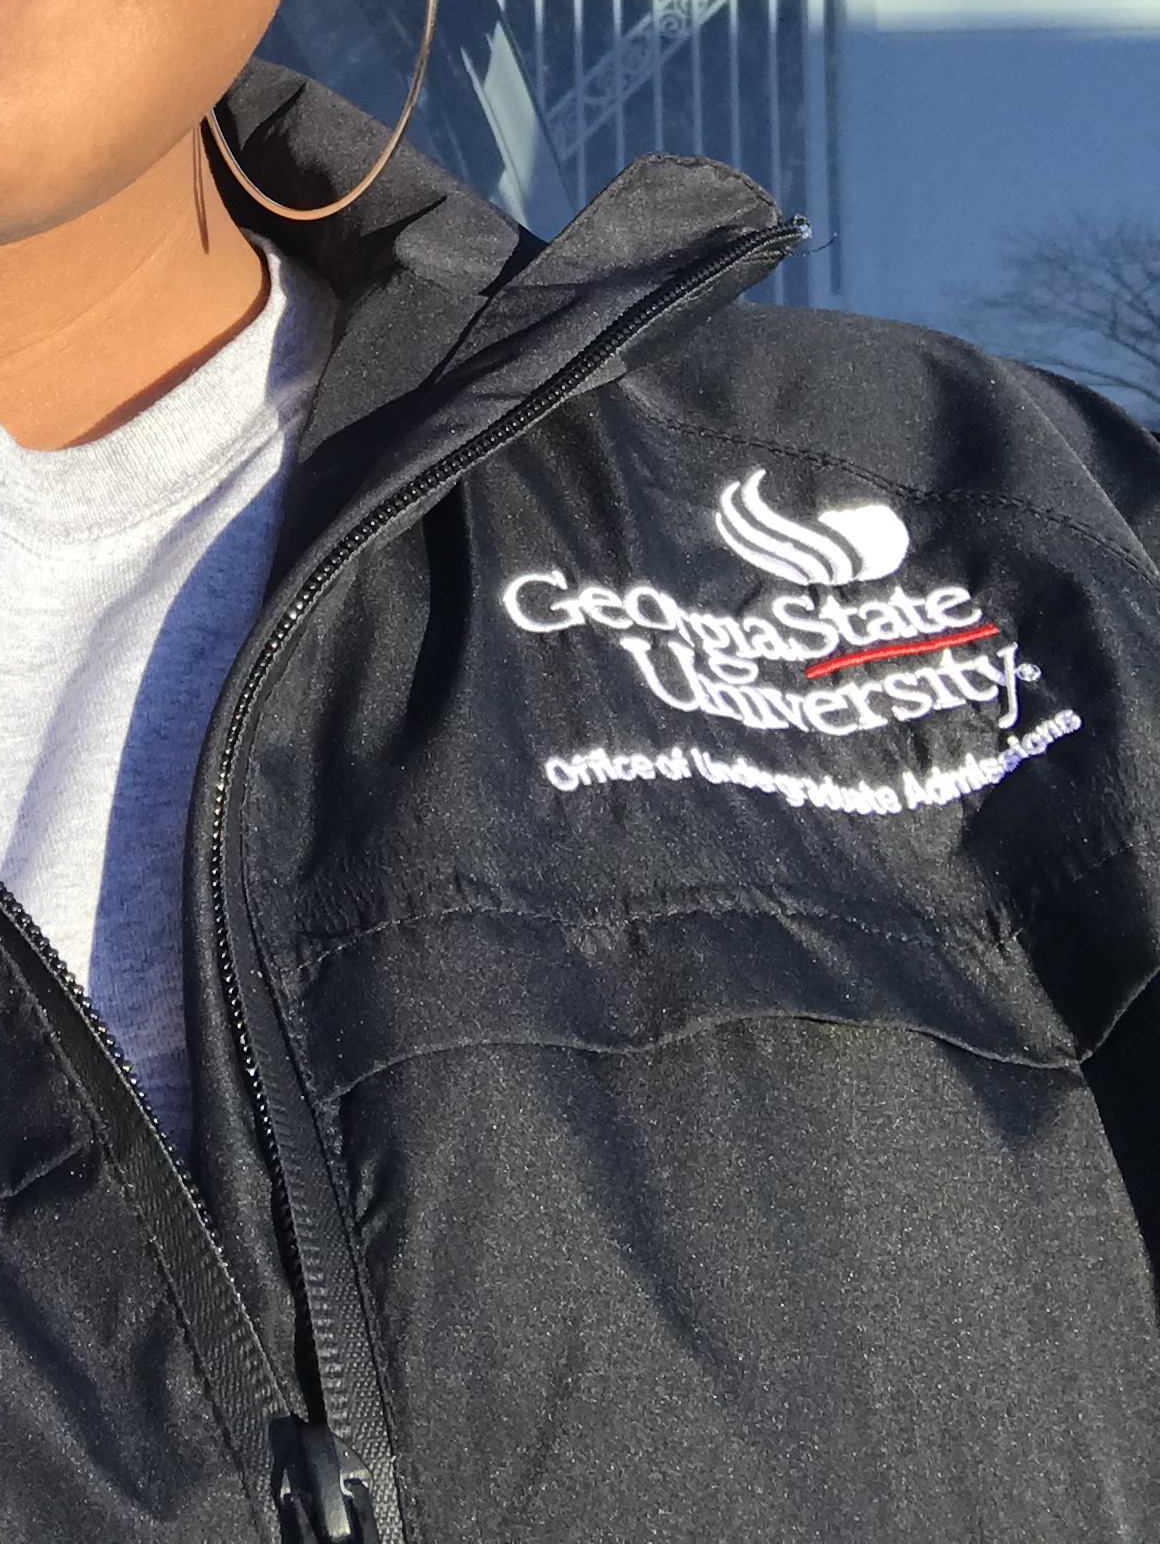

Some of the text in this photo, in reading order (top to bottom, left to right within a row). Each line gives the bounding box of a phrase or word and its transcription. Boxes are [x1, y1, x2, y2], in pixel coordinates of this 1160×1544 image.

[503, 571, 982, 684] Georgia State
[545, 709, 1082, 815] Office of Undergraduate Admissions
